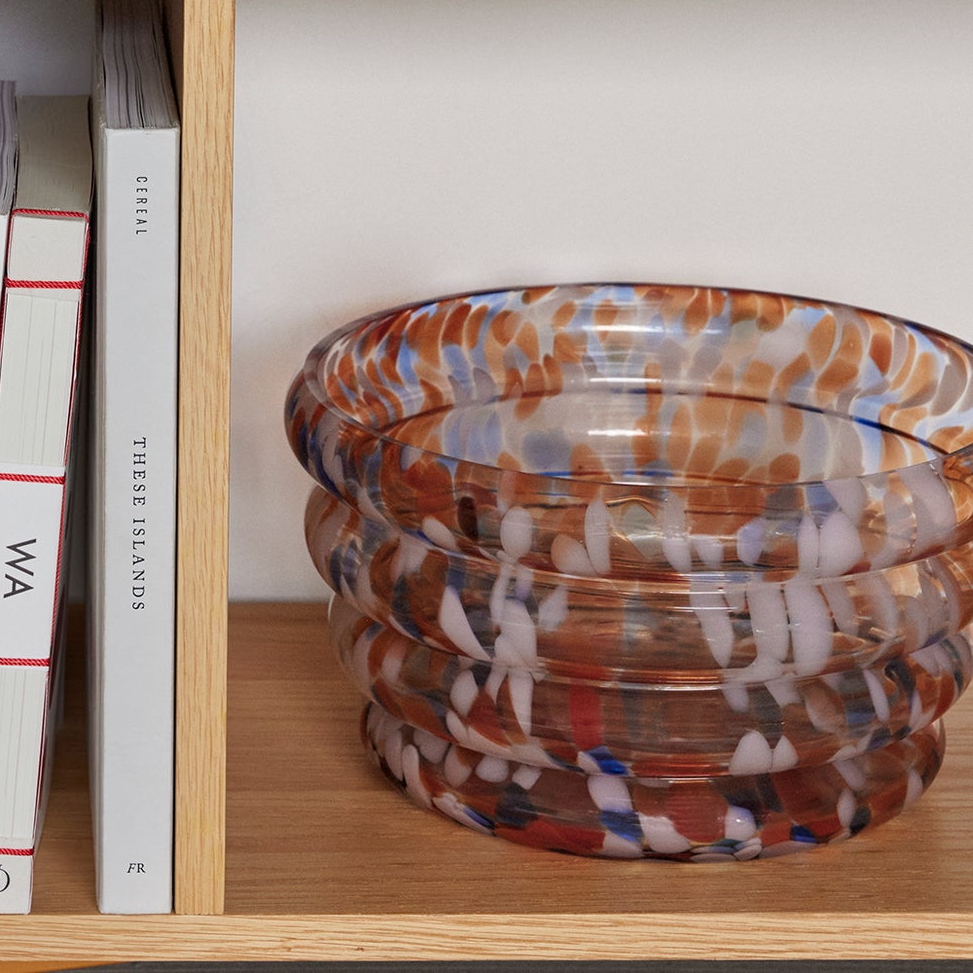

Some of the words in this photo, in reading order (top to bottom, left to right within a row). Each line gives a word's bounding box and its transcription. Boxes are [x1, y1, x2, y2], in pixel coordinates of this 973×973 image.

[135, 176, 148, 235] CEREAL
[132, 436, 147, 507] THESE
[3, 538, 37, 599] WA
[132, 518, 146, 610] ISLANDS
[126, 862, 146, 874] FR
